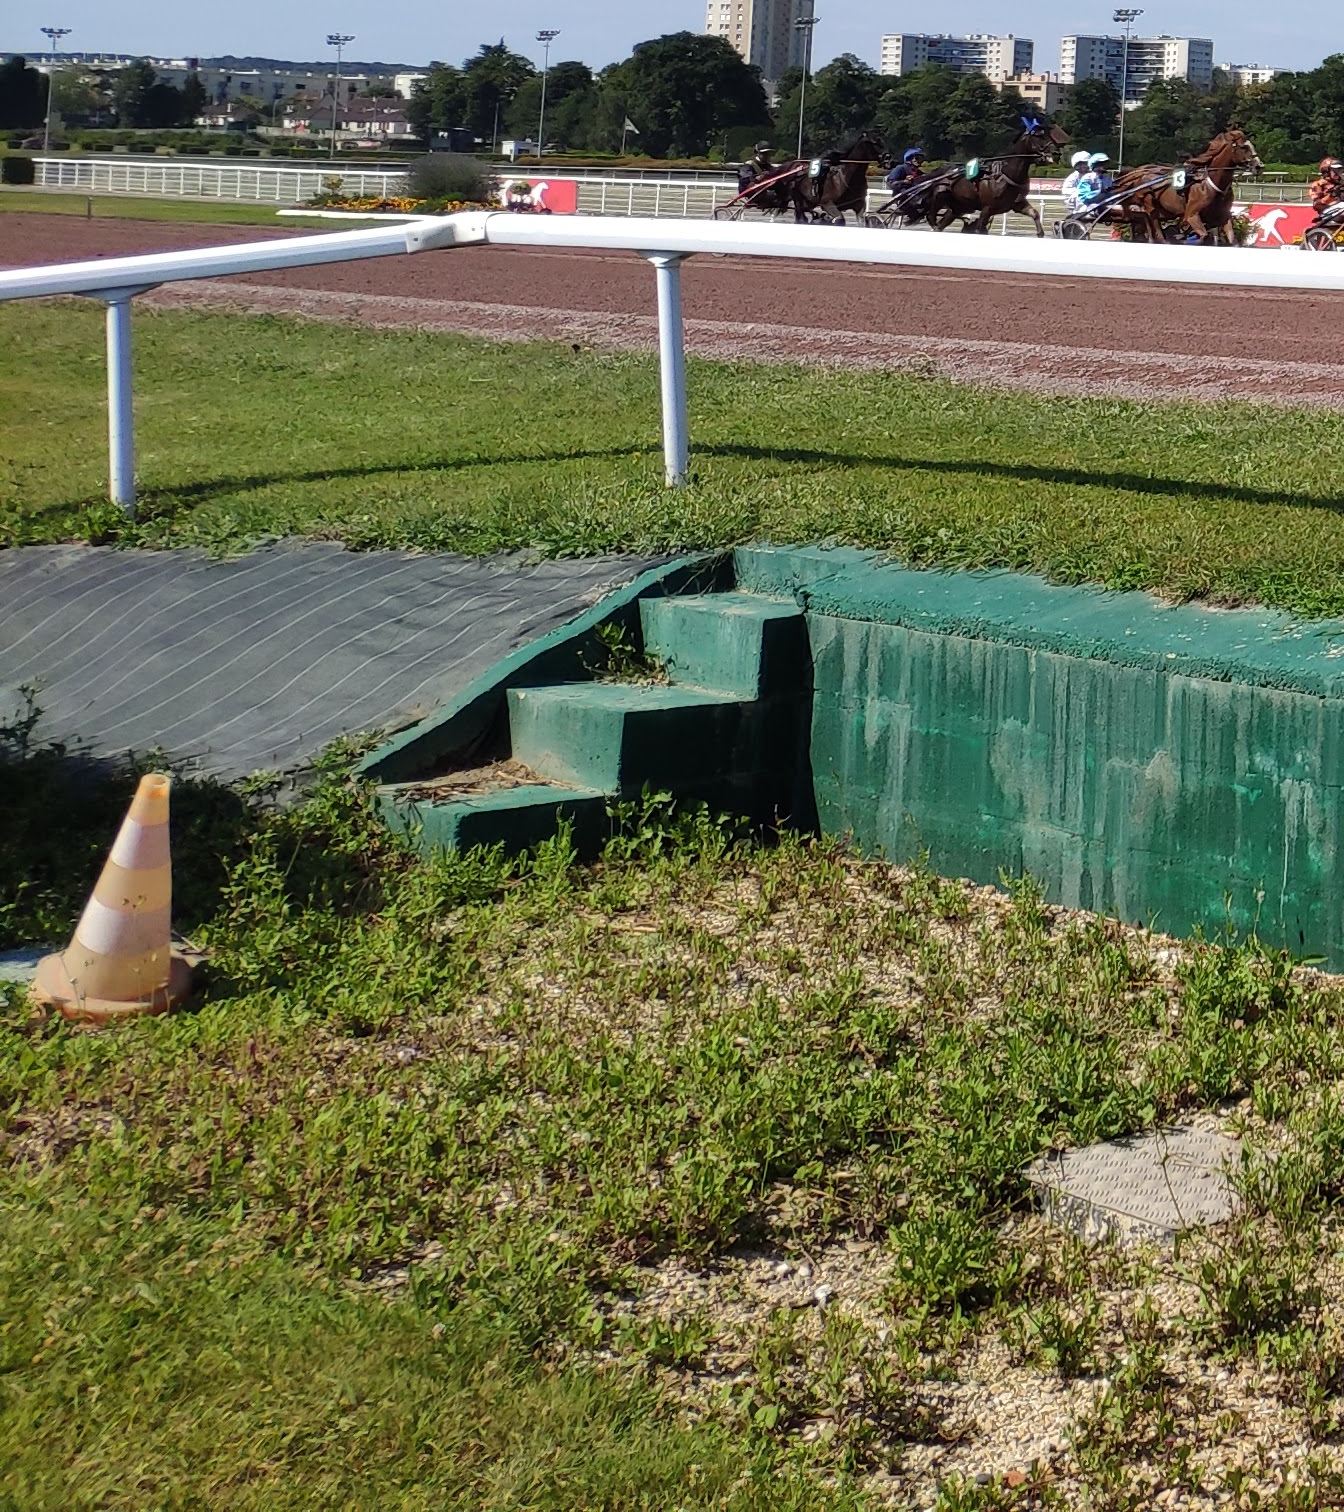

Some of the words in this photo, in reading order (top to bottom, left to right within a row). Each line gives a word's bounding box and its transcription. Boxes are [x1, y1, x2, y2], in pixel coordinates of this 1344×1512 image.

[811, 160, 820, 174] 5
[968, 158, 977, 175] 7
[1173, 170, 1186, 187] 13
